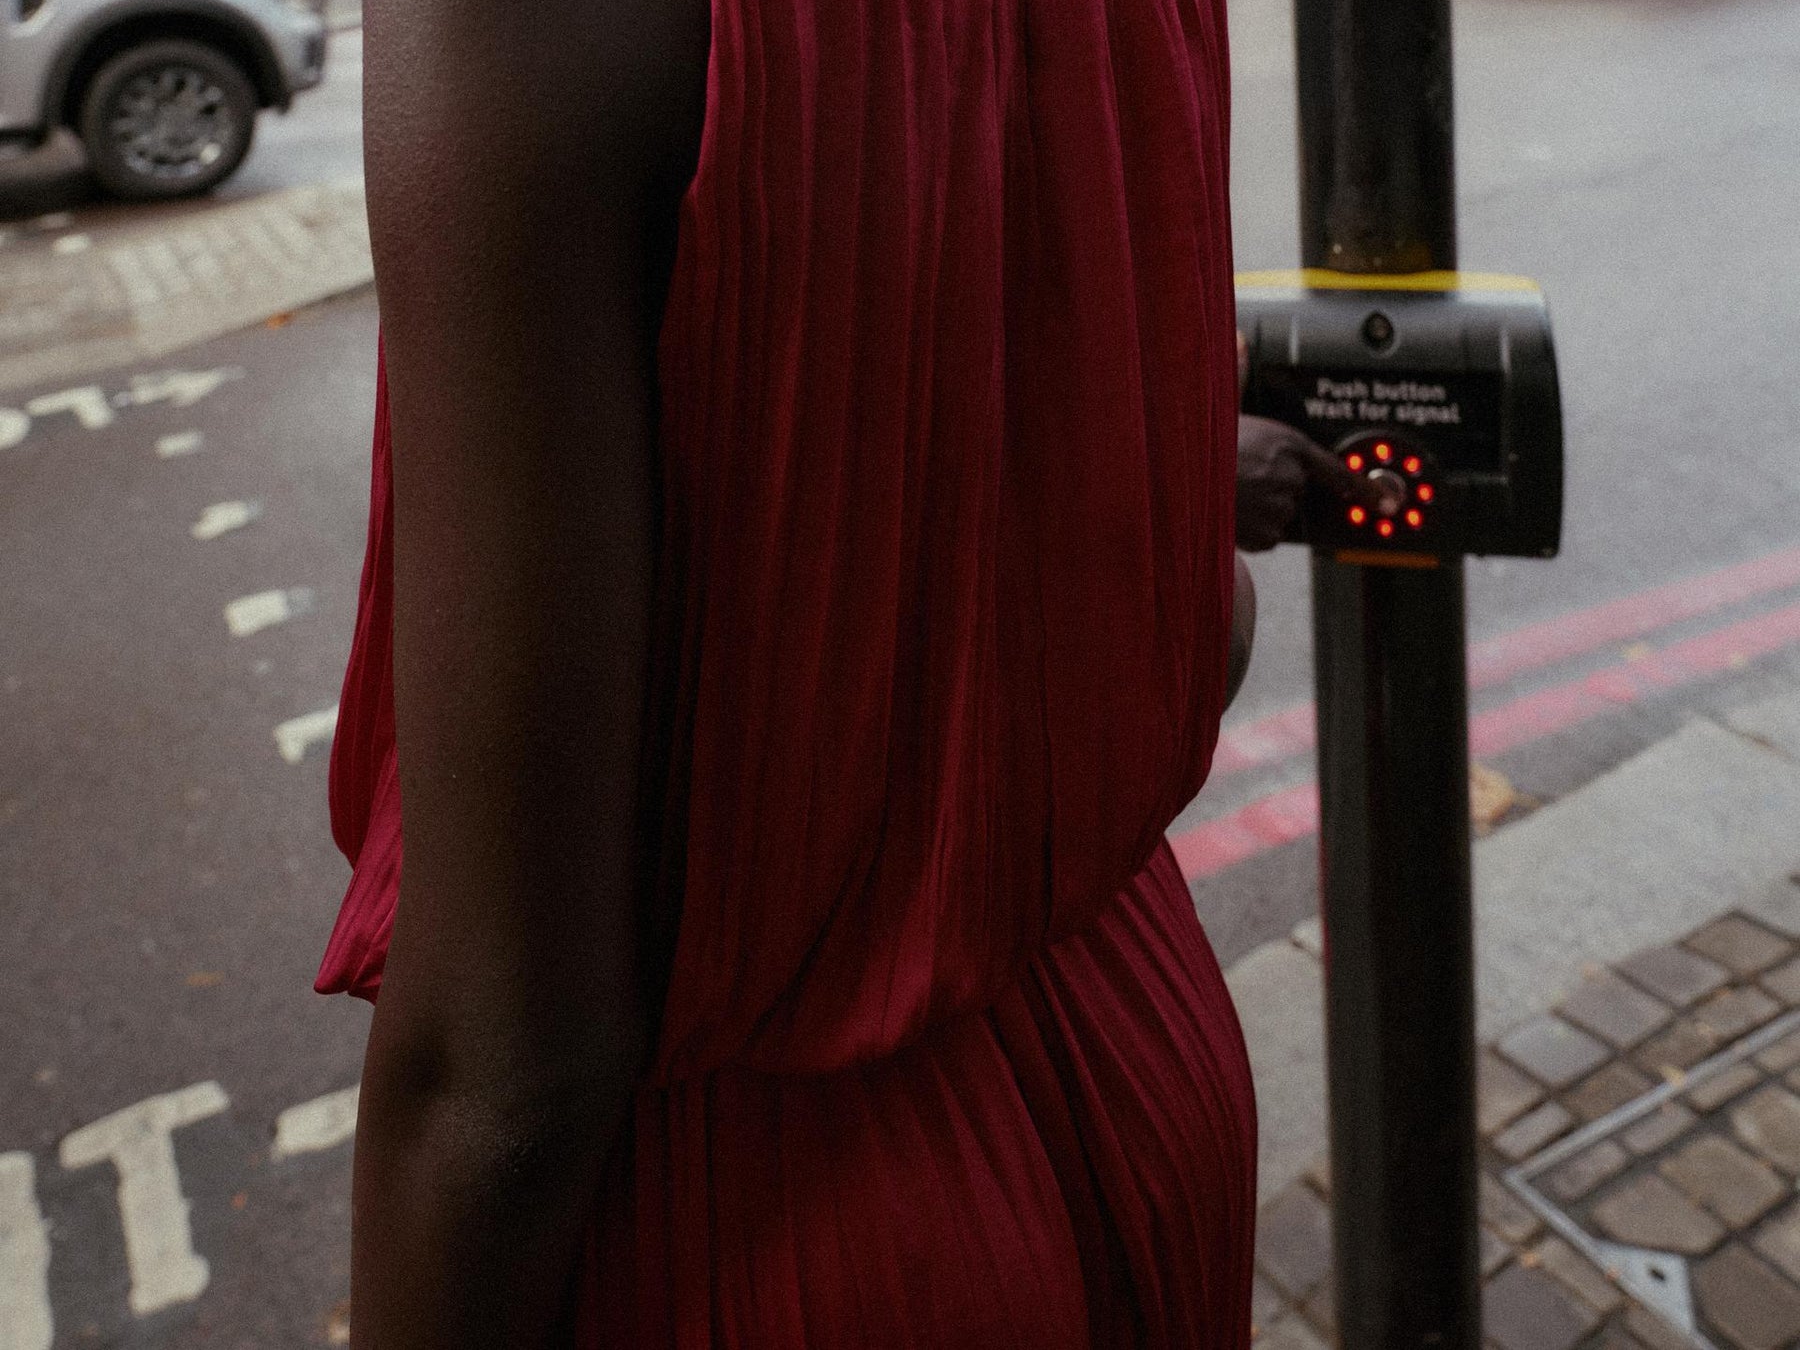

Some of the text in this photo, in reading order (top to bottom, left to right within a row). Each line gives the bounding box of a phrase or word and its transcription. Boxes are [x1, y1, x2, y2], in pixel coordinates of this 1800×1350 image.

[1316, 378, 1446, 401] Push button
[1304, 398, 1460, 426] Wait for signal
